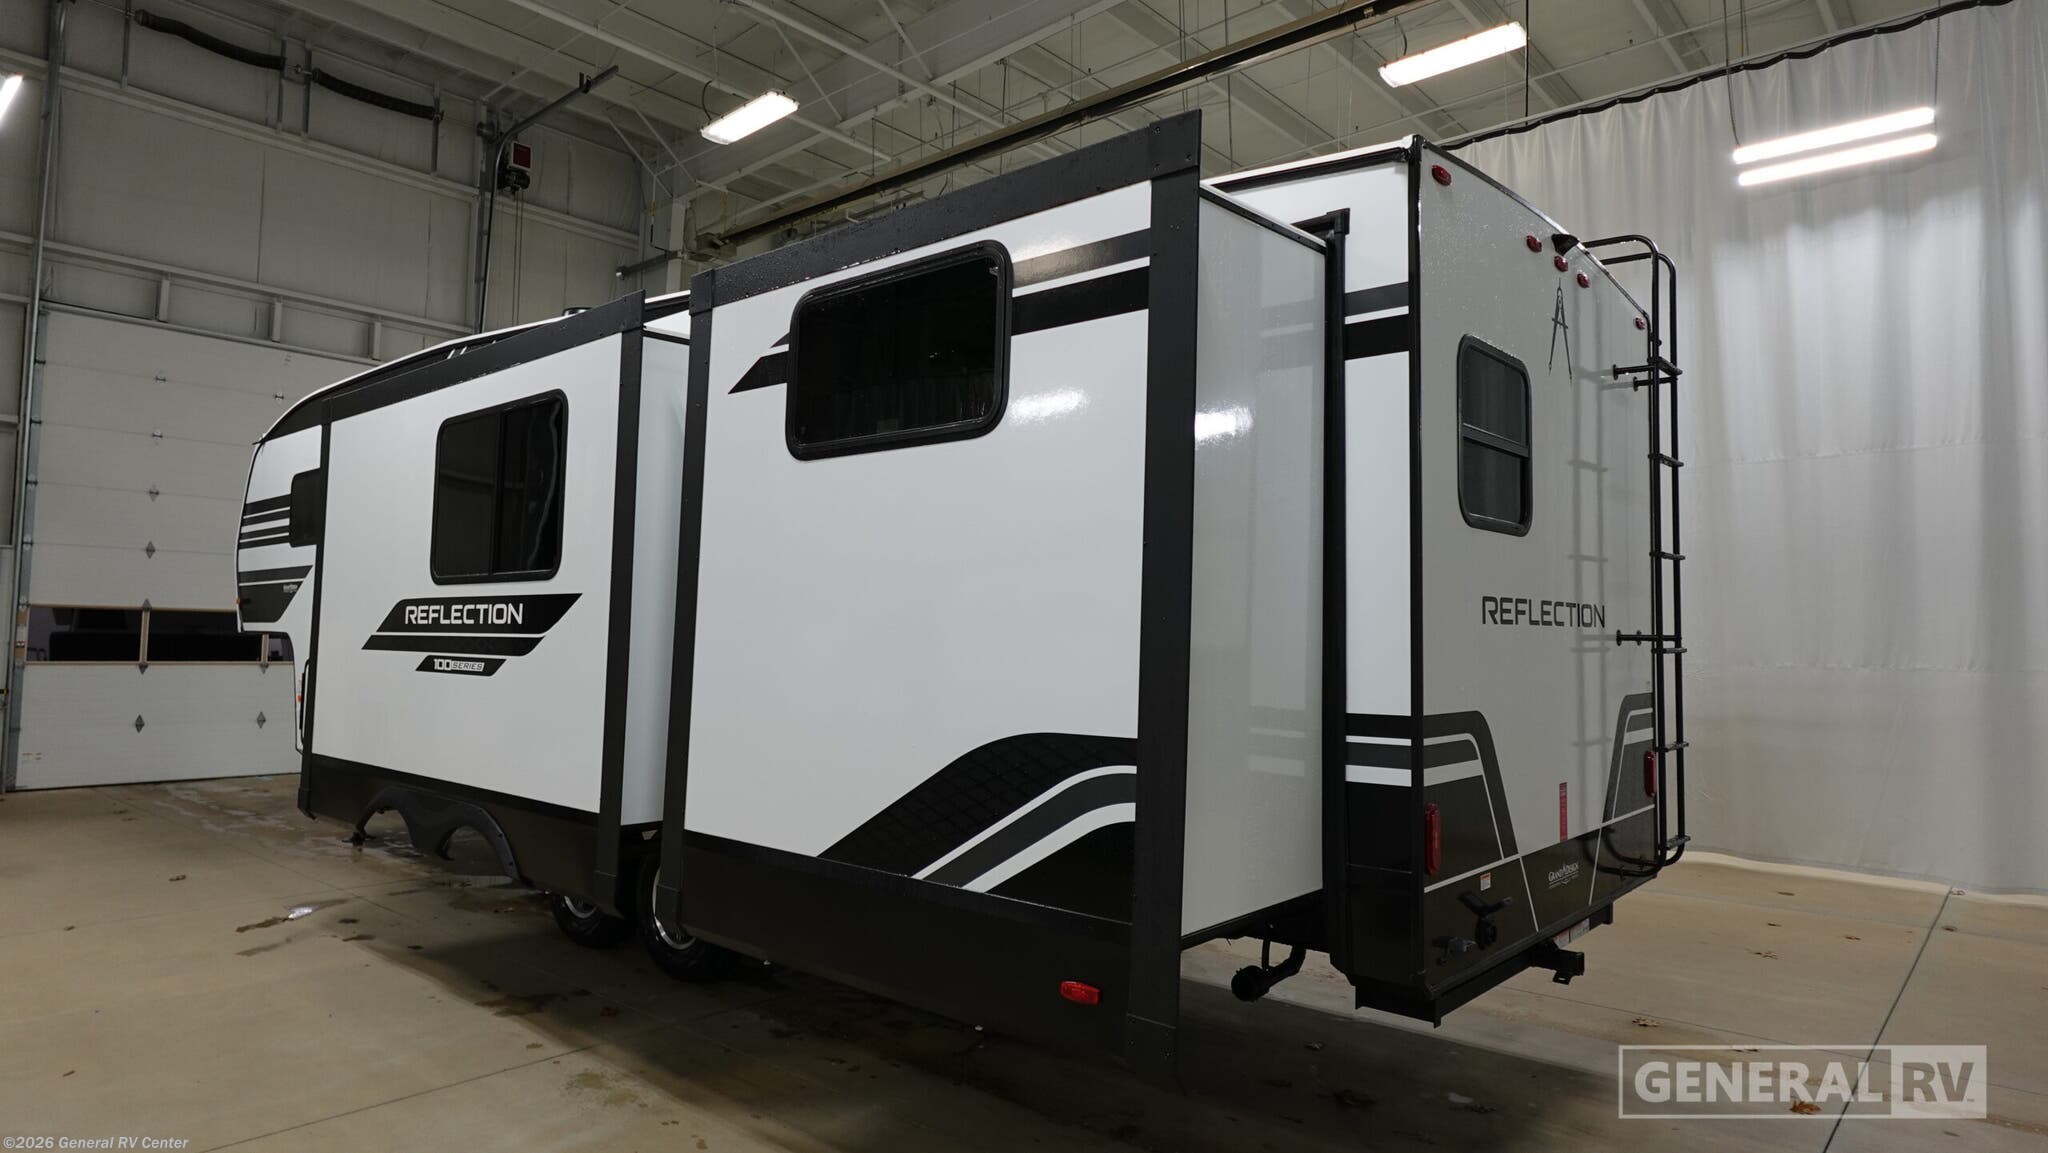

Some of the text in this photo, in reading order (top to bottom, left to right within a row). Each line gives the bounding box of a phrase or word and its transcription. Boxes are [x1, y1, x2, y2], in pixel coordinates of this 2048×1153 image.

[405, 603, 523, 625] REFLECTION
[1482, 595, 1605, 628] REFLECTION
[434, 659, 484, 672] 100 SERIES
